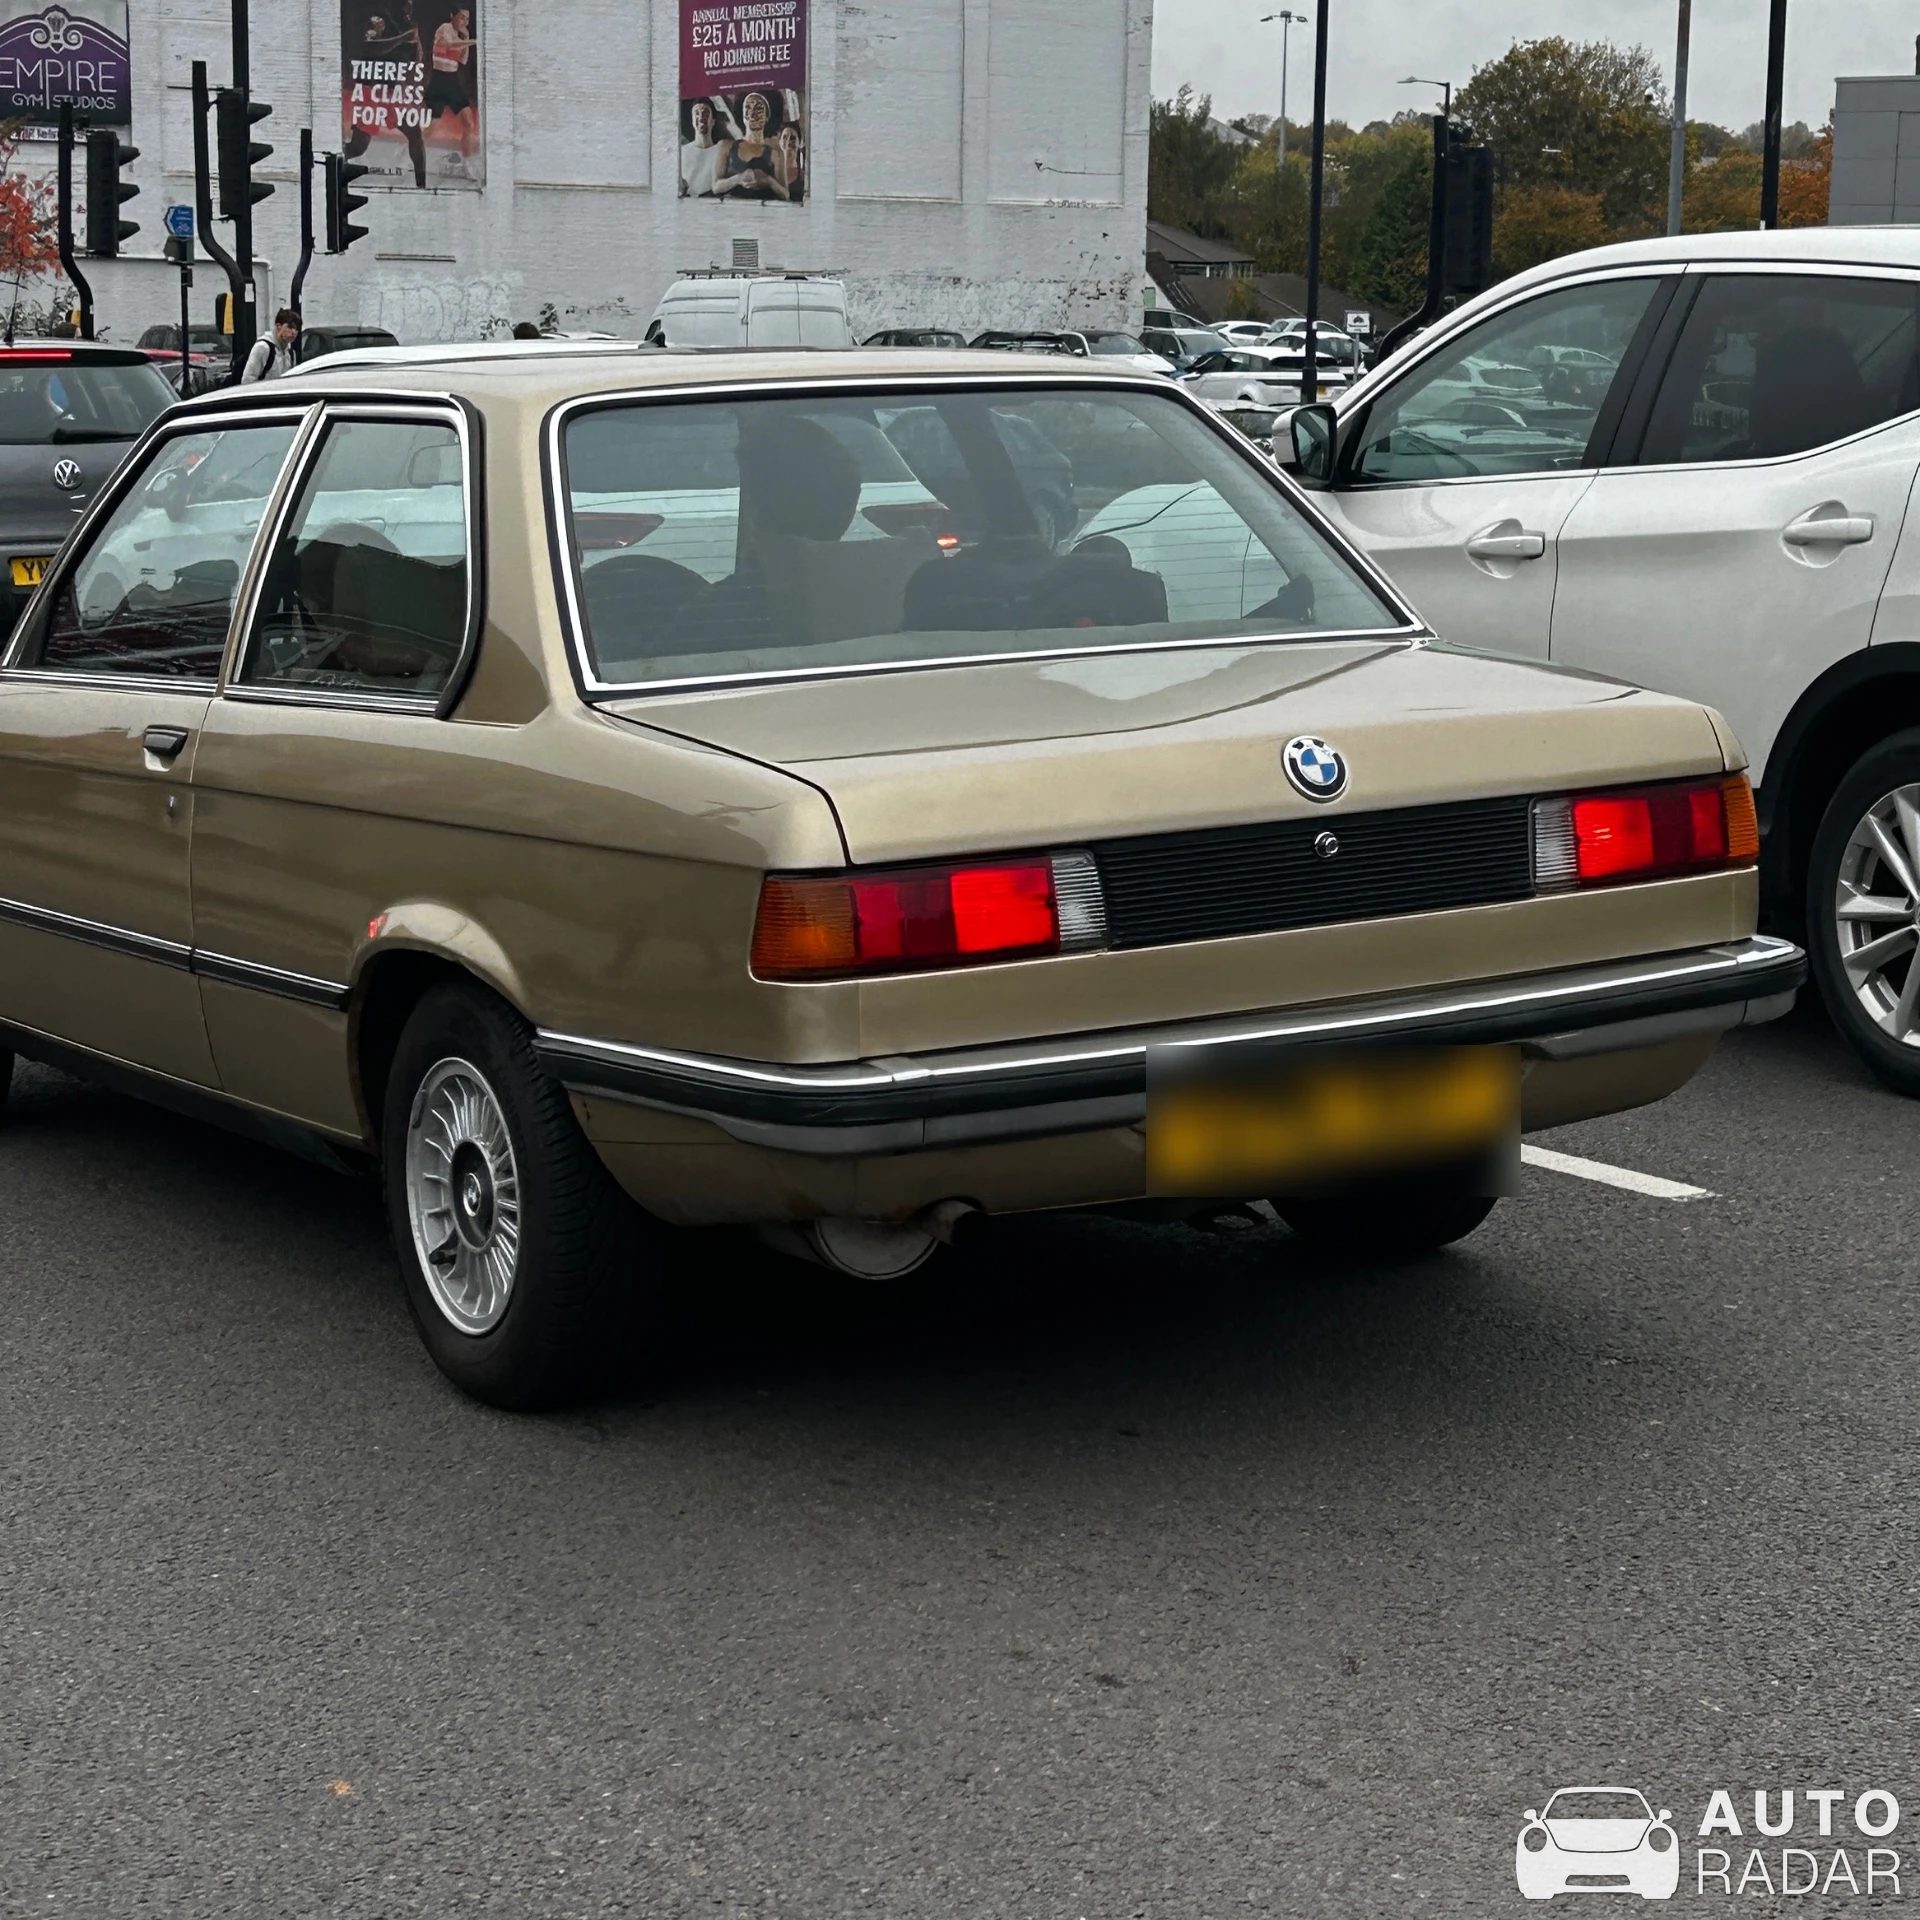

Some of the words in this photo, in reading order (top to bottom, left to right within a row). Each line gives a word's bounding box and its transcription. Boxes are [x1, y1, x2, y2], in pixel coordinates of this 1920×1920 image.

[692, 24, 722, 47] £25
[726, 22, 737, 45] A
[704, 50, 720, 68] NO
[722, 46, 766, 67] JOINING
[769, 44, 791, 61] FEE
[350, 60, 425, 82] THERE'S
[0, 57, 117, 110] EMPIRE
[350, 83, 364, 102] A
[370, 83, 425, 105] CLASS
[12, 93, 44, 107] GYM
[352, 105, 388, 127] FOR
[394, 107, 433, 129] YOU
